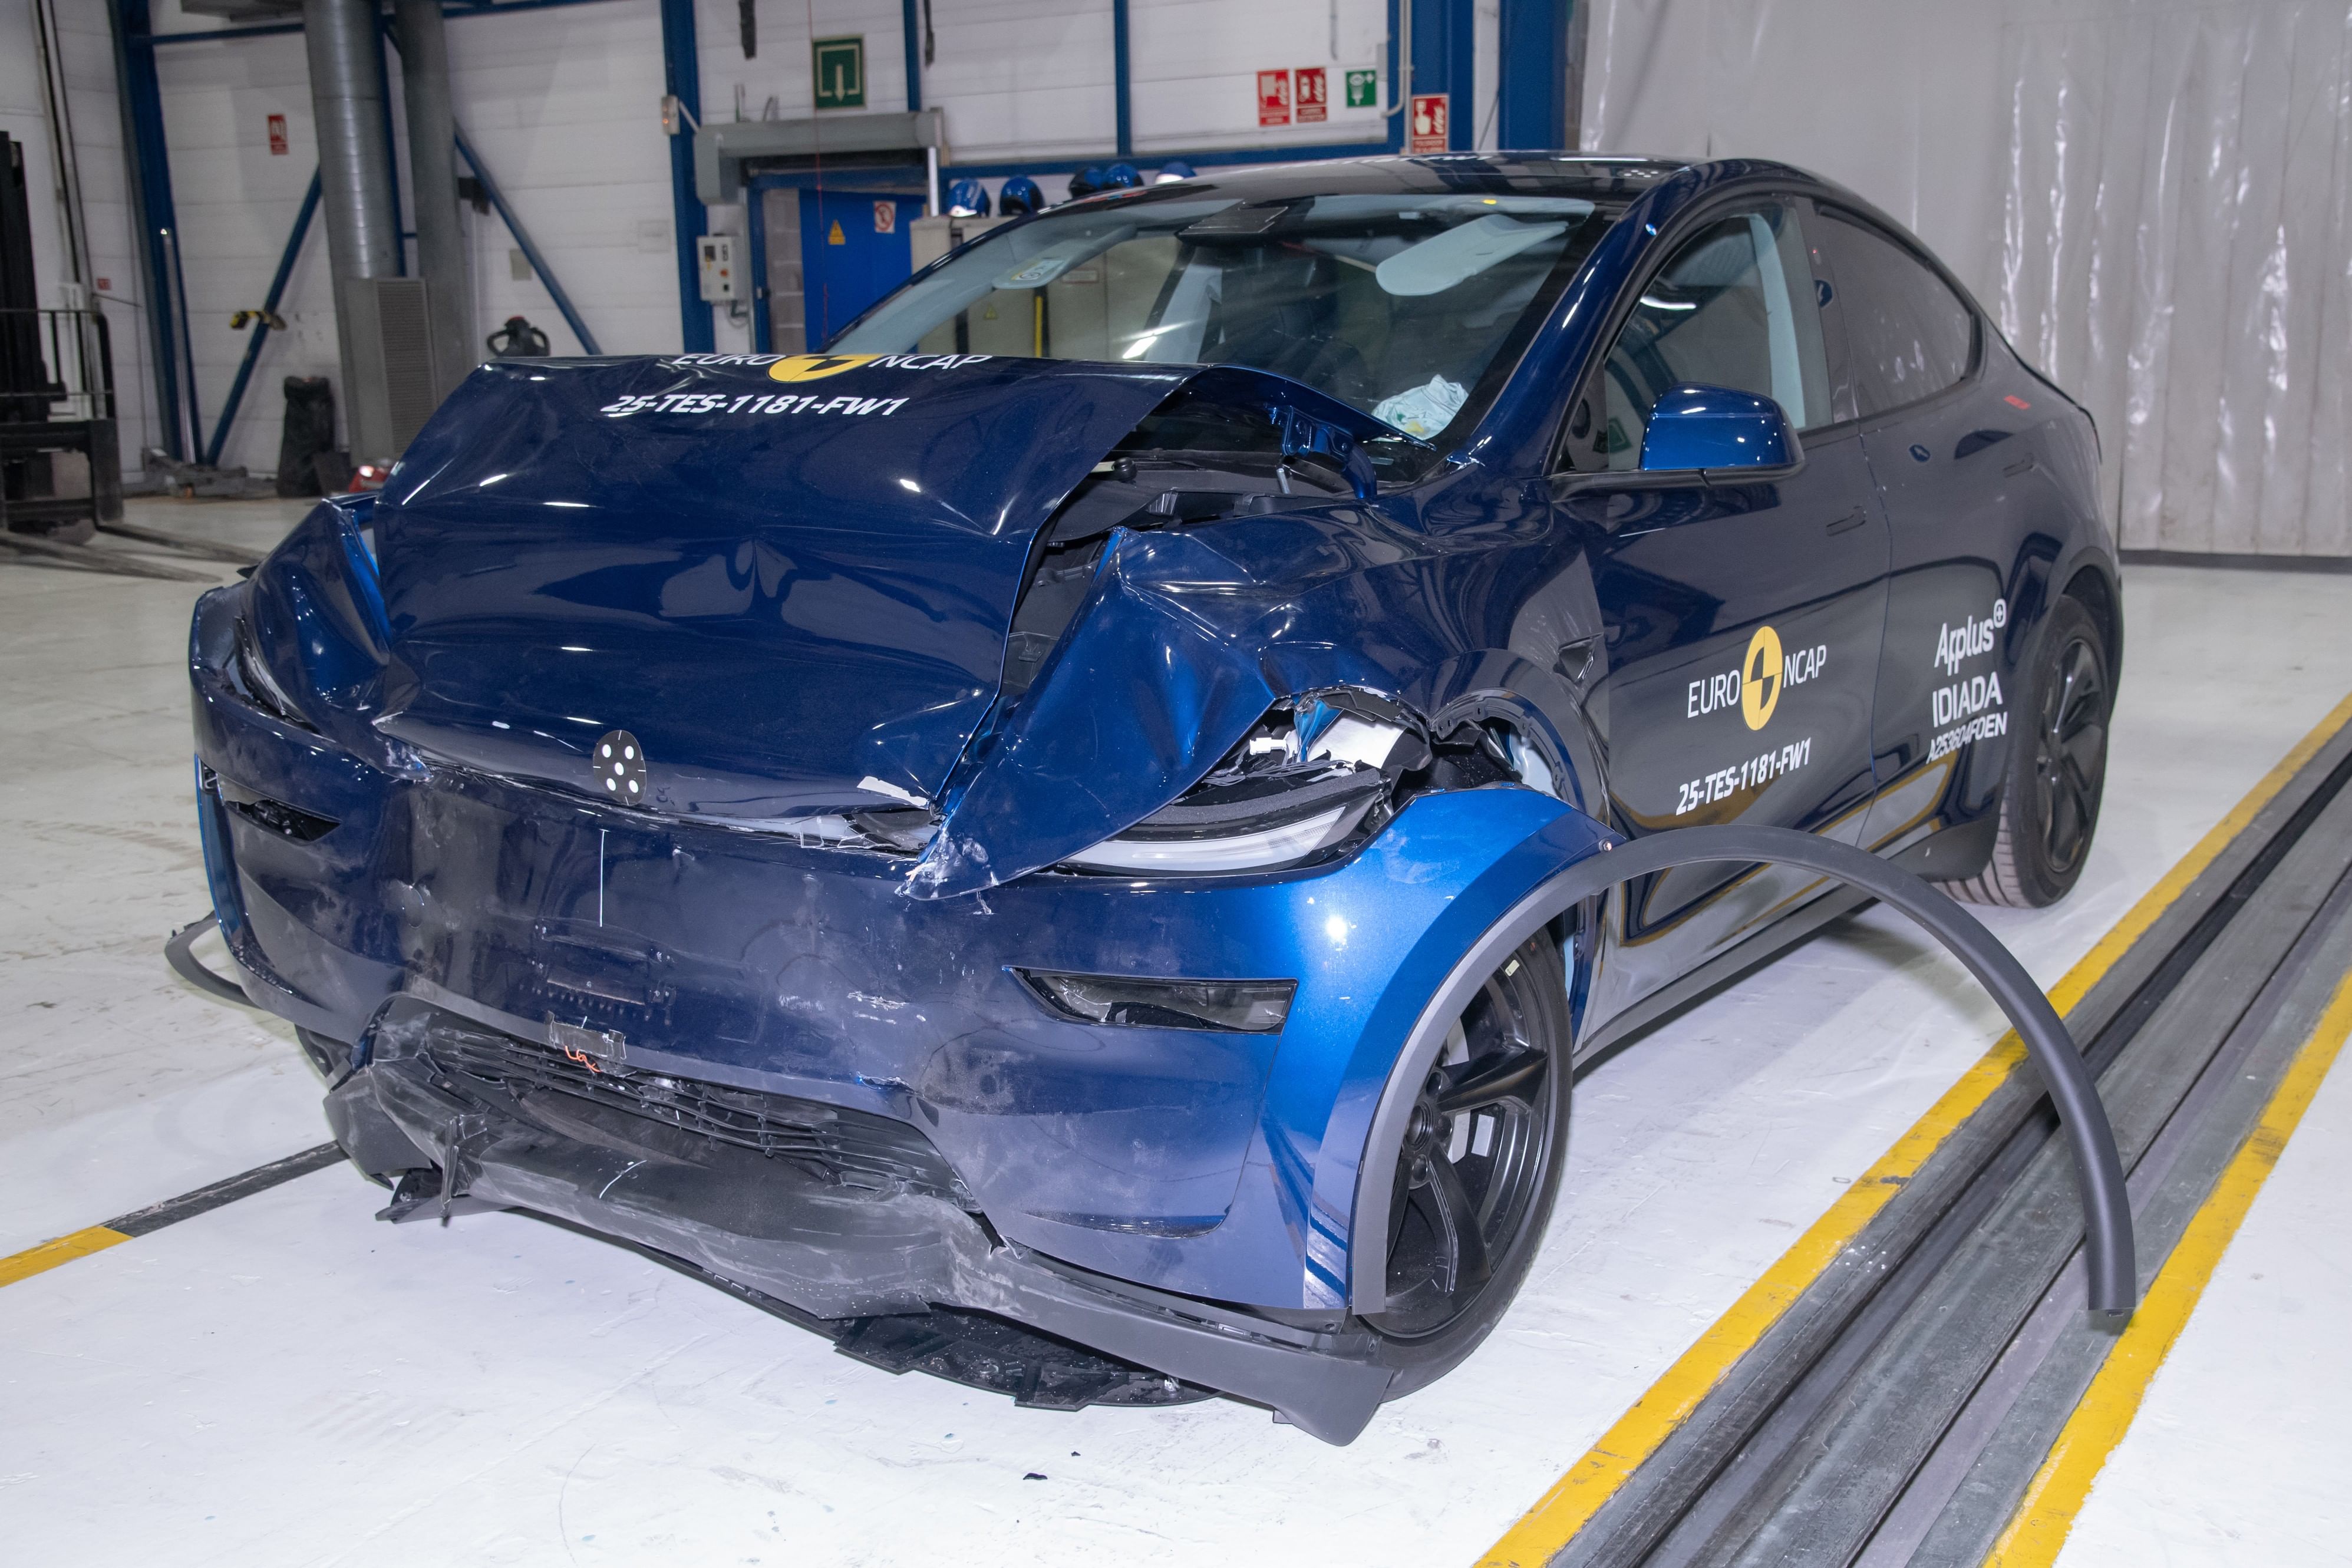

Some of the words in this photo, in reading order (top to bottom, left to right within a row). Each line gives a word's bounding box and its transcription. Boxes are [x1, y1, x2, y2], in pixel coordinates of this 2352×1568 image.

[671, 354, 786, 365] EURO
[868, 354, 994, 369] NCAP
[600, 394, 910, 415] 25-TES-1181-FW1
[1687, 669, 1741, 718] EURO
[1783, 645, 1827, 688] NCAP
[1932, 671, 2003, 728] IDIADA
[1675, 737, 1812, 816] 25-TES-1181-FW1
